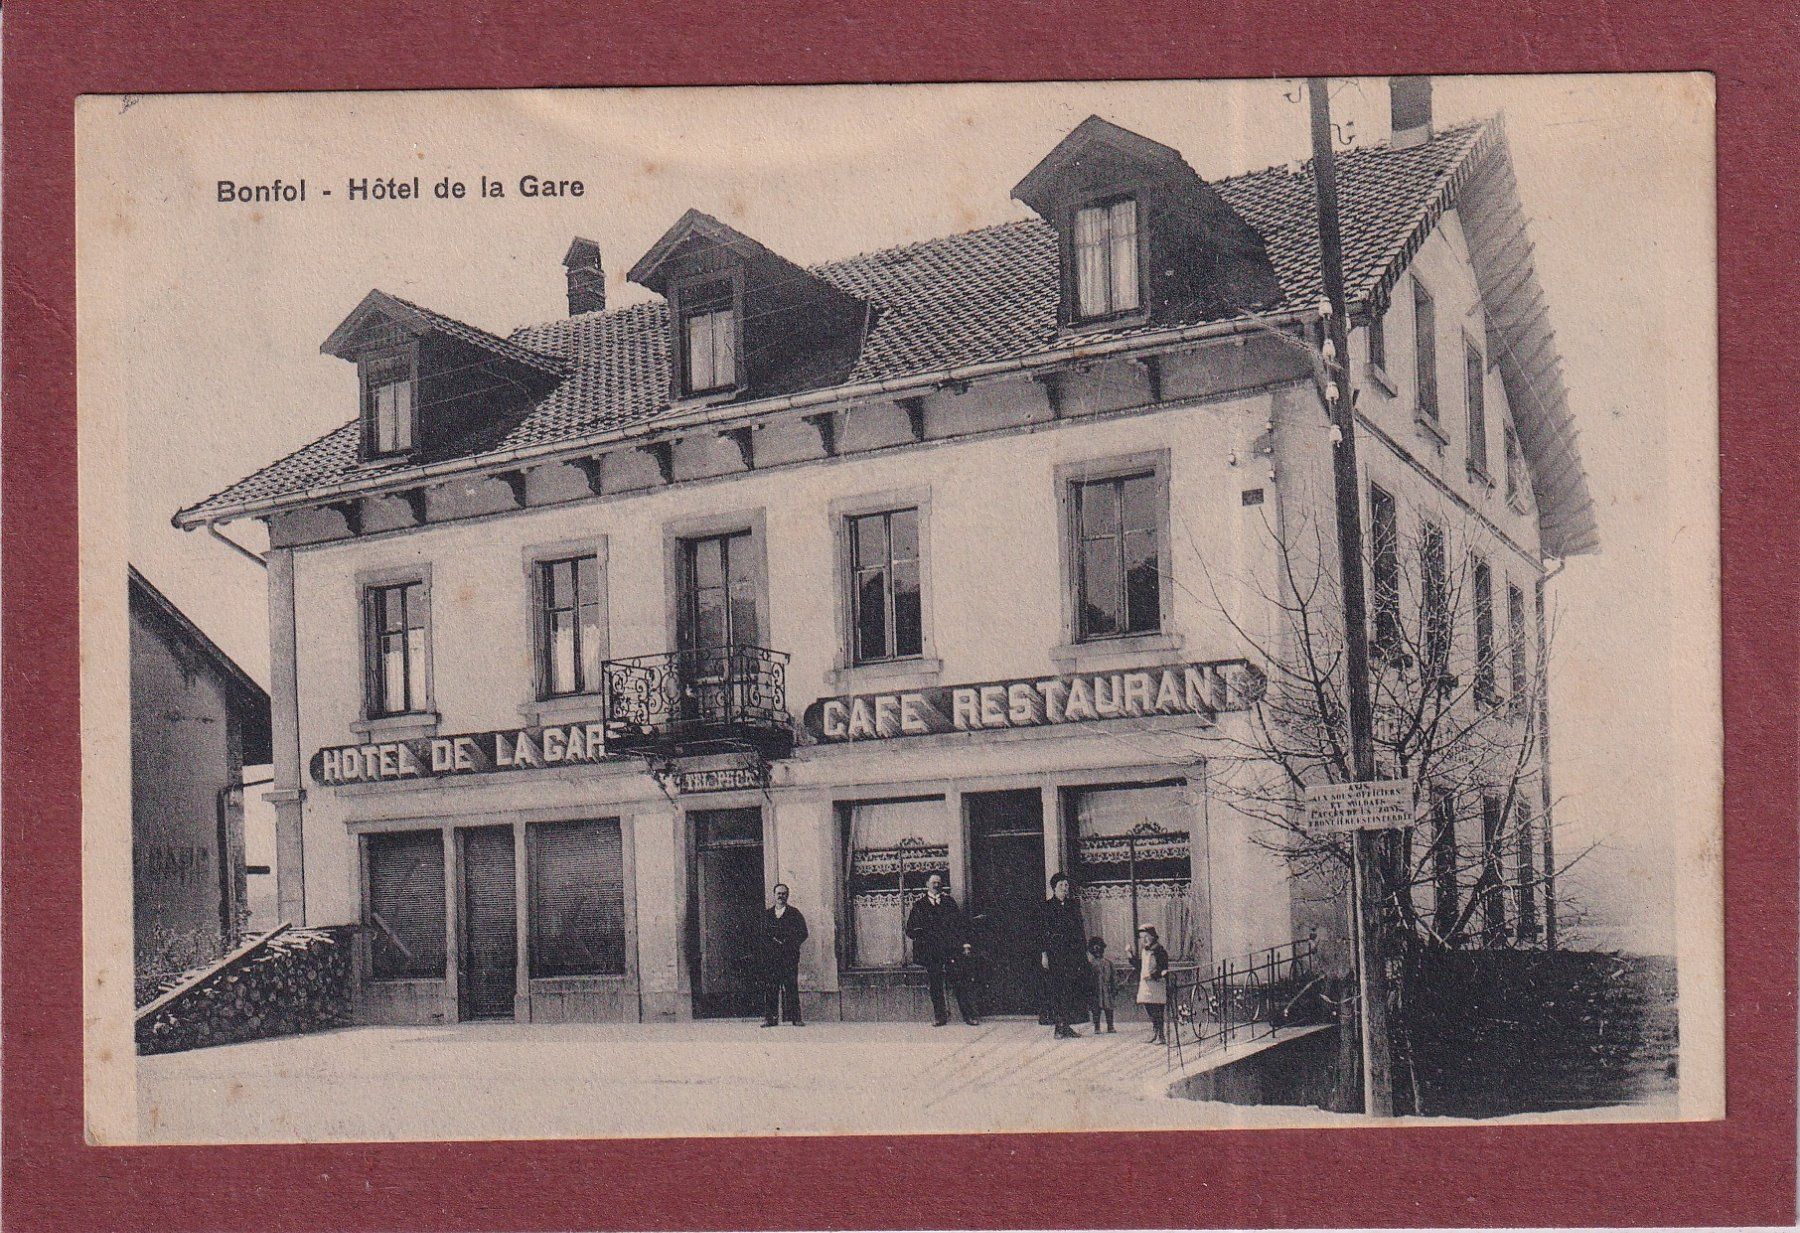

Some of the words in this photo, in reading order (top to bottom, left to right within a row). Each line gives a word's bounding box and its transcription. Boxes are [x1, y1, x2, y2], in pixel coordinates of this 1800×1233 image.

[822, 692, 927, 738] CAFE
[952, 663, 1245, 729] RESTAURANT
[322, 744, 416, 782] HOTEL
[431, 737, 474, 772] DE
[496, 730, 538, 766] LA
[686, 769, 765, 793] TELPHON
